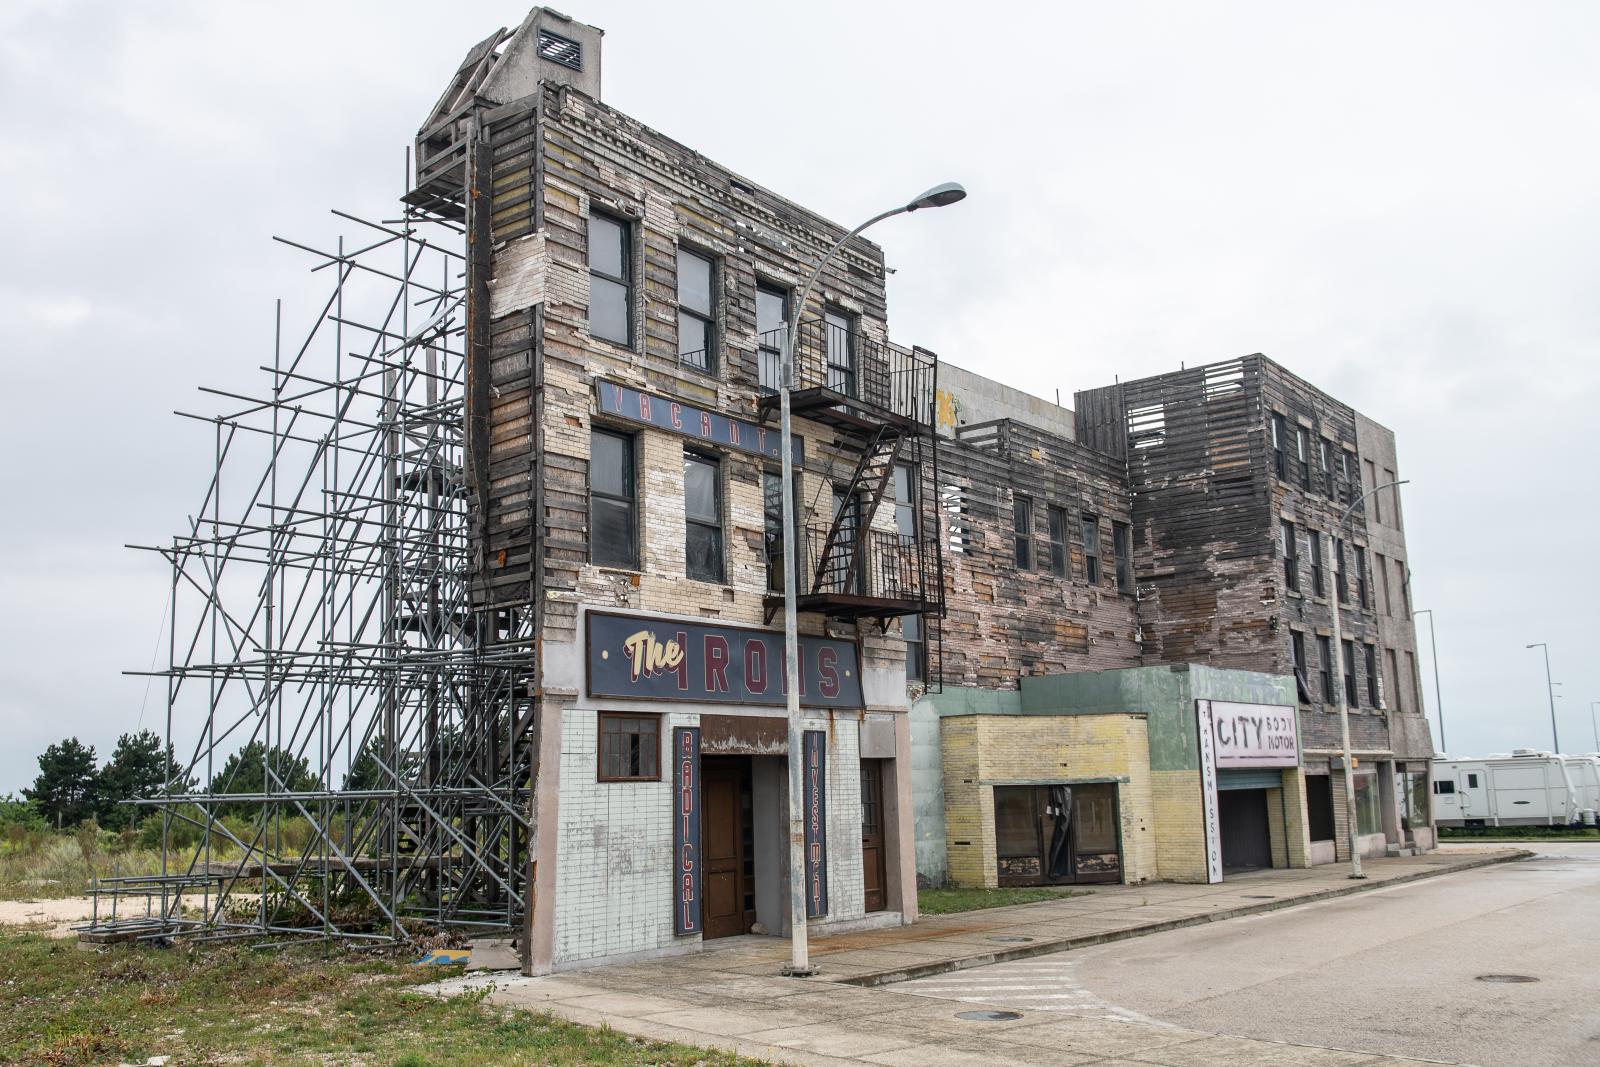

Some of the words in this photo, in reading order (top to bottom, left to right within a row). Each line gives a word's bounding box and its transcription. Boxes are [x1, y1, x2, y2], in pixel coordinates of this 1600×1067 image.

[623, 630, 684, 683] The
[1217, 715, 1263, 750] CITY
[1268, 735, 1295, 750] MOTOR
[681, 731, 694, 930] RADICAL
[811, 732, 821, 915] INVESTMENT
